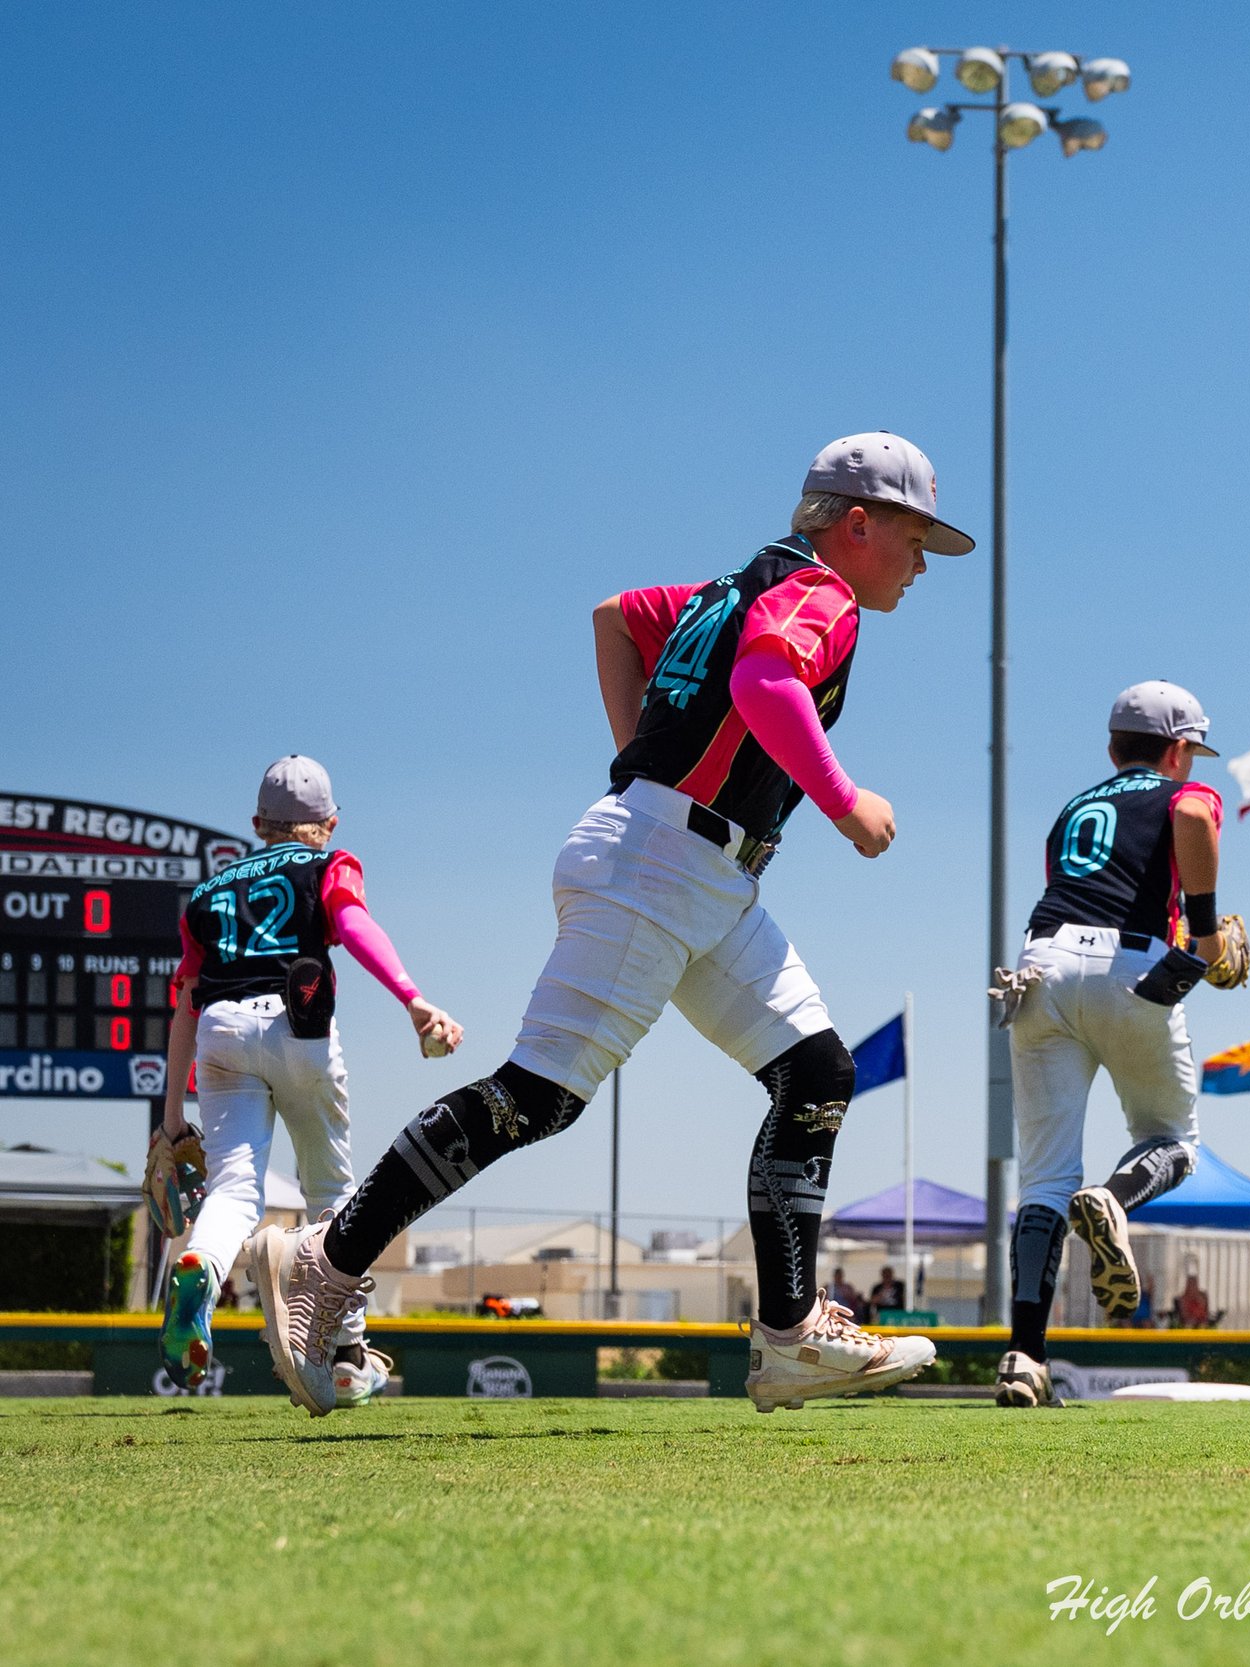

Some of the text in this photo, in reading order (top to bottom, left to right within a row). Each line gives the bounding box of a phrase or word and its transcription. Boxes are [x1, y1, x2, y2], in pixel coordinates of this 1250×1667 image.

[63, 806, 199, 856] REGION
[1060, 801, 1117, 878] 0
[9, 856, 186, 879] DATIONS
[4, 891, 70, 919] OUT
[84, 889, 111, 934] 0
[210, 874, 299, 964] 12
[2, 953, 13, 971] 8
[31, 953, 42, 971] 9
[57, 954, 74, 972] 10
[84, 955, 140, 975] RUNS
[111, 973, 131, 1008] 0
[110, 1015, 131, 1050] 0
[0, 1054, 104, 1092] rdino
